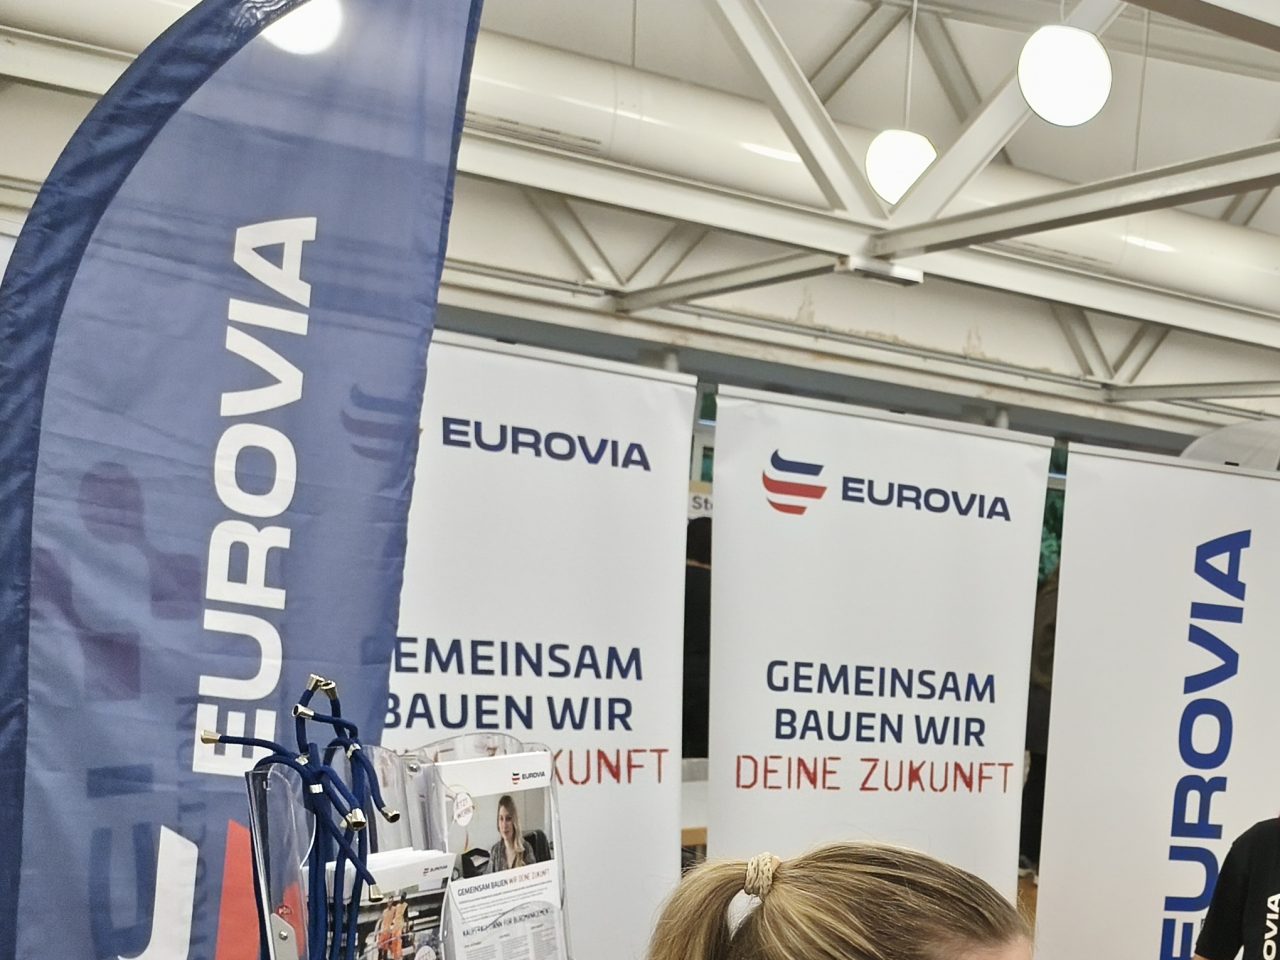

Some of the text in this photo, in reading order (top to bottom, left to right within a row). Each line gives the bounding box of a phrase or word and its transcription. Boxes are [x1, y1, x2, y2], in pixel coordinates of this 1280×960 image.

[441, 417, 651, 471] EUROVIA
[192, 216, 317, 778] EUROVIA
[841, 476, 1012, 522] EUROVIA
[394, 636, 643, 681] EMEINSAM
[766, 660, 996, 703] GEMEINSAM
[382, 692, 632, 731] BAUEN WIR
[775, 708, 985, 747] BAUEN WIR
[521, 771, 546, 780] EUROVIA
[551, 748, 669, 785] KUNFT
[736, 755, 1014, 794] DEINE ZUKUNFT
[457, 883, 491, 897] GEMEINSAM
[491, 879, 509, 890] BAUEN
